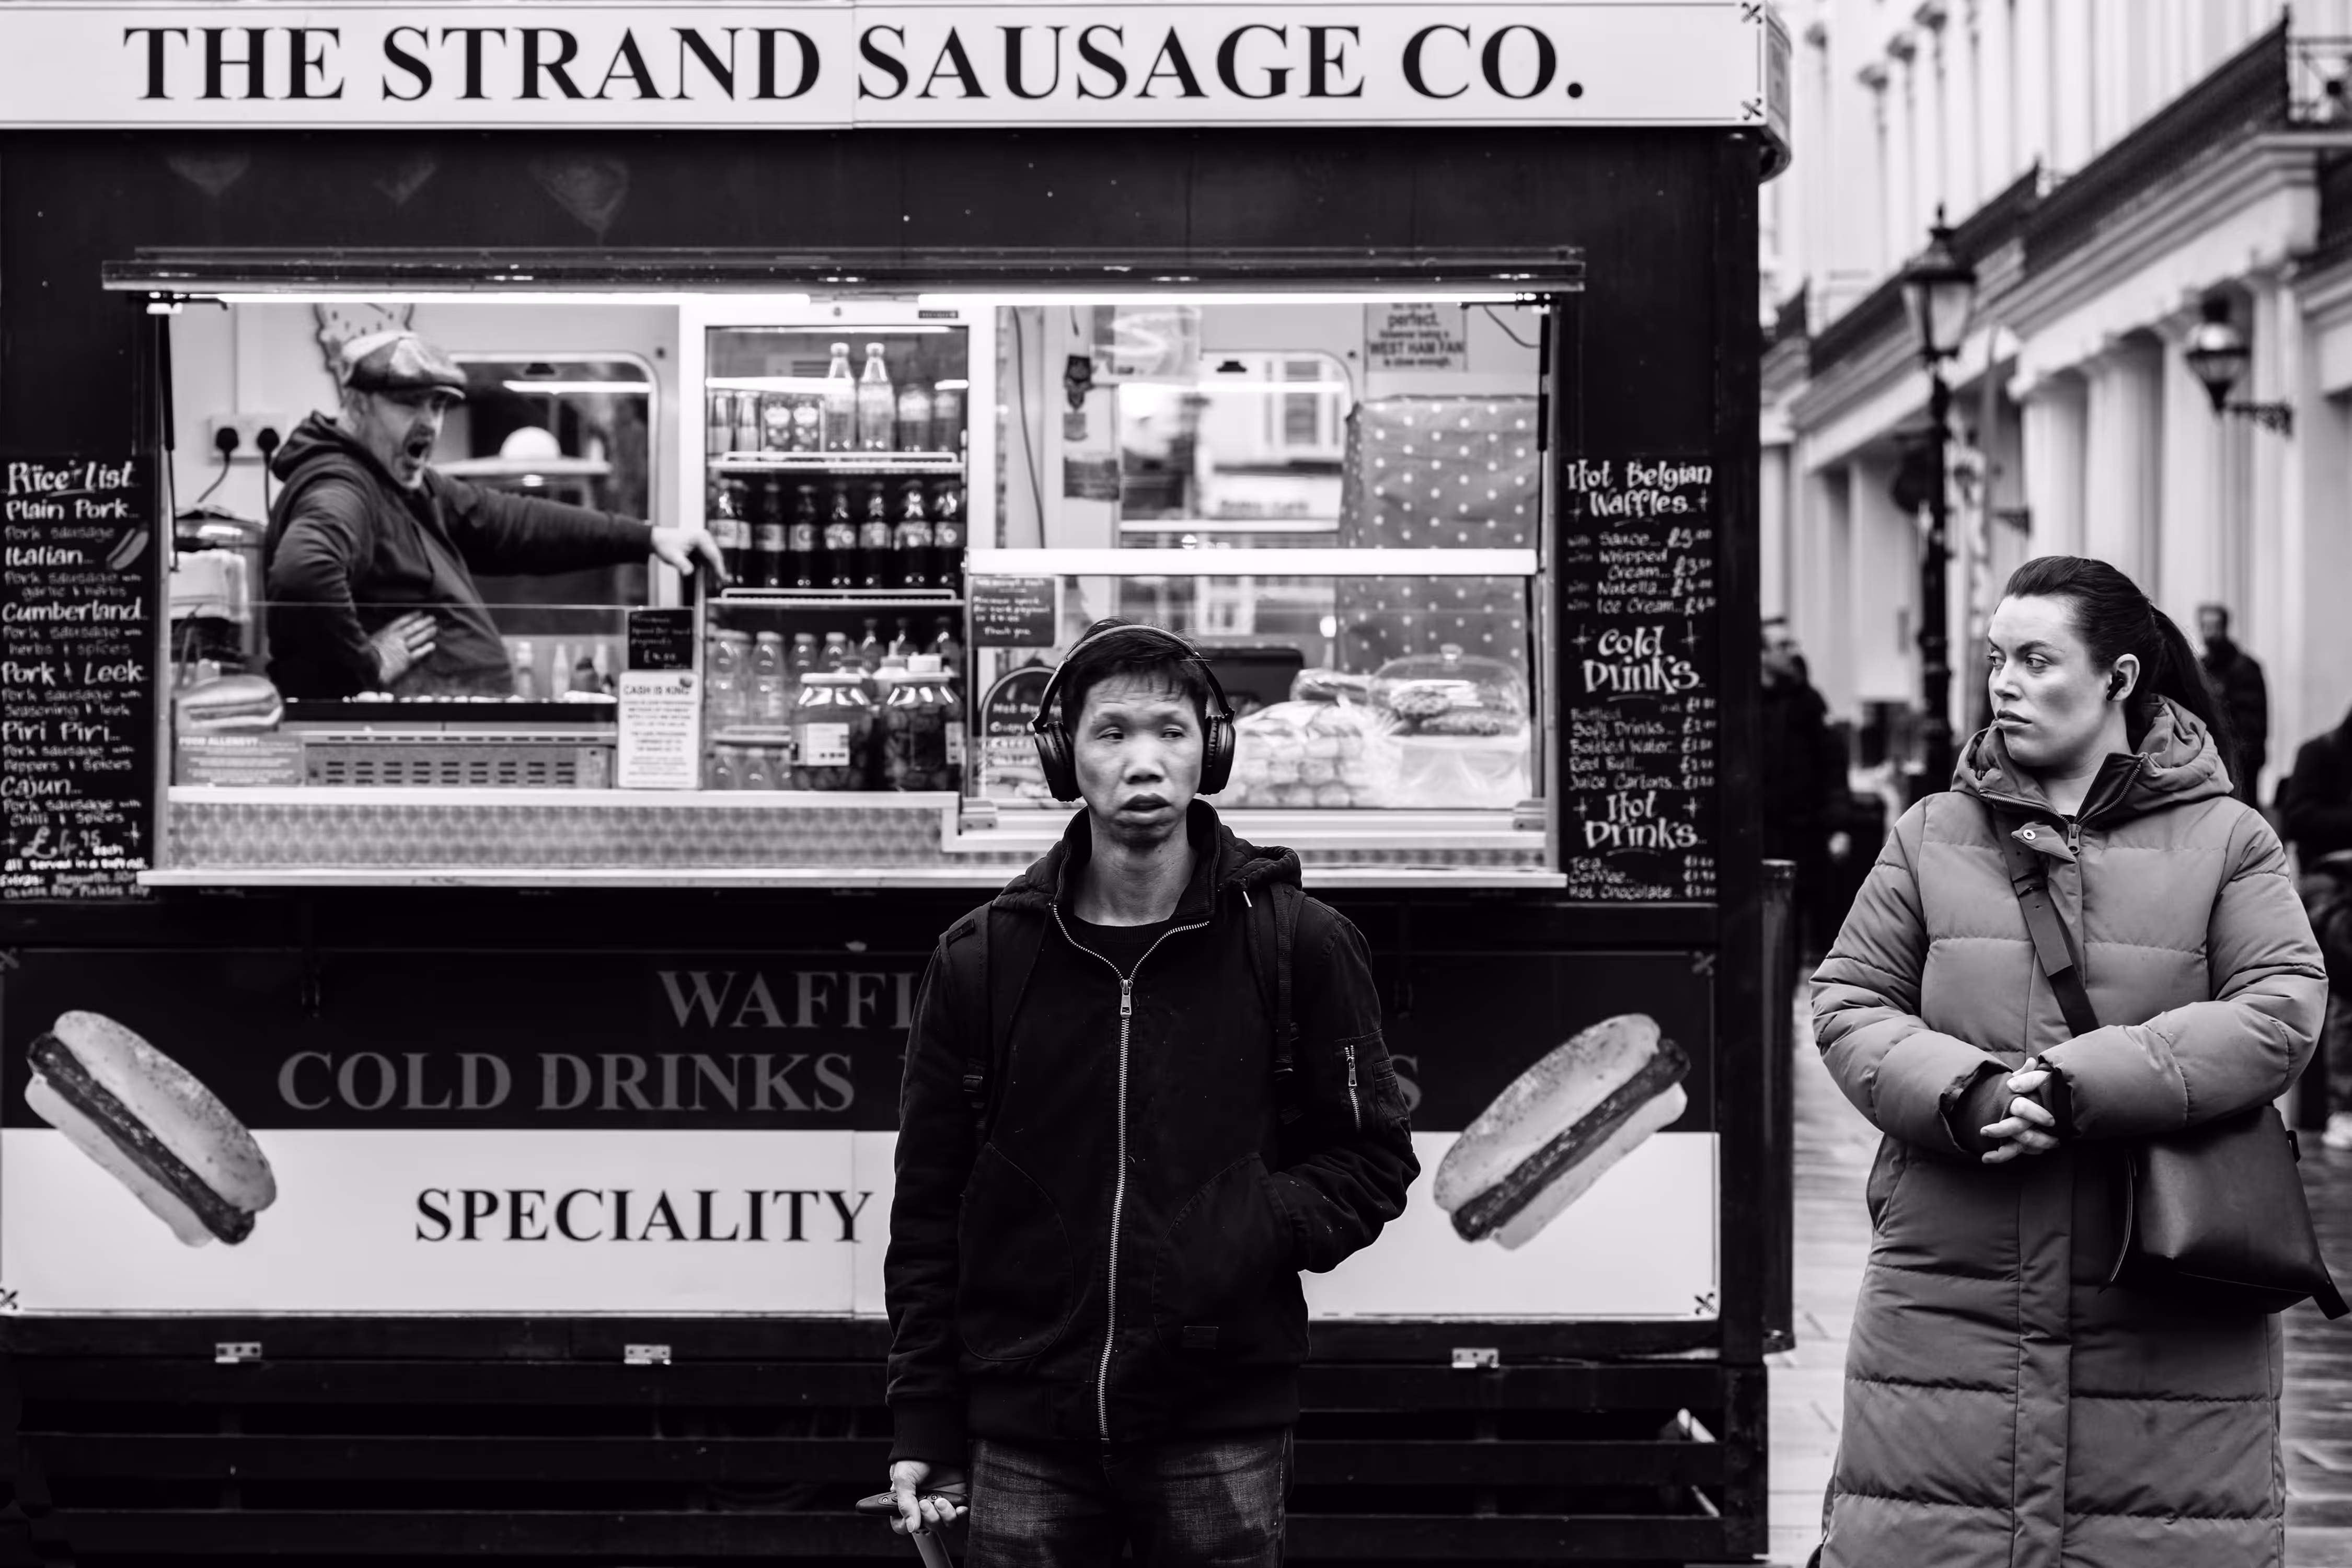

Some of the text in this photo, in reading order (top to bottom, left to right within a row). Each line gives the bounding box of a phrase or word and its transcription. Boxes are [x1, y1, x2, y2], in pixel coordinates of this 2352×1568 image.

[123, 24, 1584, 101] THE STRAND SAUSAGE CO.
[1370, 341, 1465, 355] WEST HAM FAN
[1567, 459, 1713, 493] Hot Belgian
[5, 498, 129, 521] Plain Pork
[1589, 487, 1689, 518] Waffles
[5, 546, 84, 567] Italian
[2, 596, 143, 622] Cumberland
[1597, 625, 1665, 660] Cold
[1, 660, 56, 686] Pork
[84, 659, 145, 685] Leek
[1582, 655, 1700, 695] Drinks
[624, 686, 651, 695] CASH
[665, 685, 690, 695] KING
[2, 720, 110, 743] Piri Piri
[178, 736, 206, 746] FOOD
[1, 775, 72, 799] Cajun
[1606, 790, 1657, 824] Hot
[1584, 817, 1699, 849] Drinks
[659, 972, 911, 1029] WAFFL
[277, 1051, 855, 1112] COLD DRINKS
[416, 1188, 874, 1243] SPECIALITY
